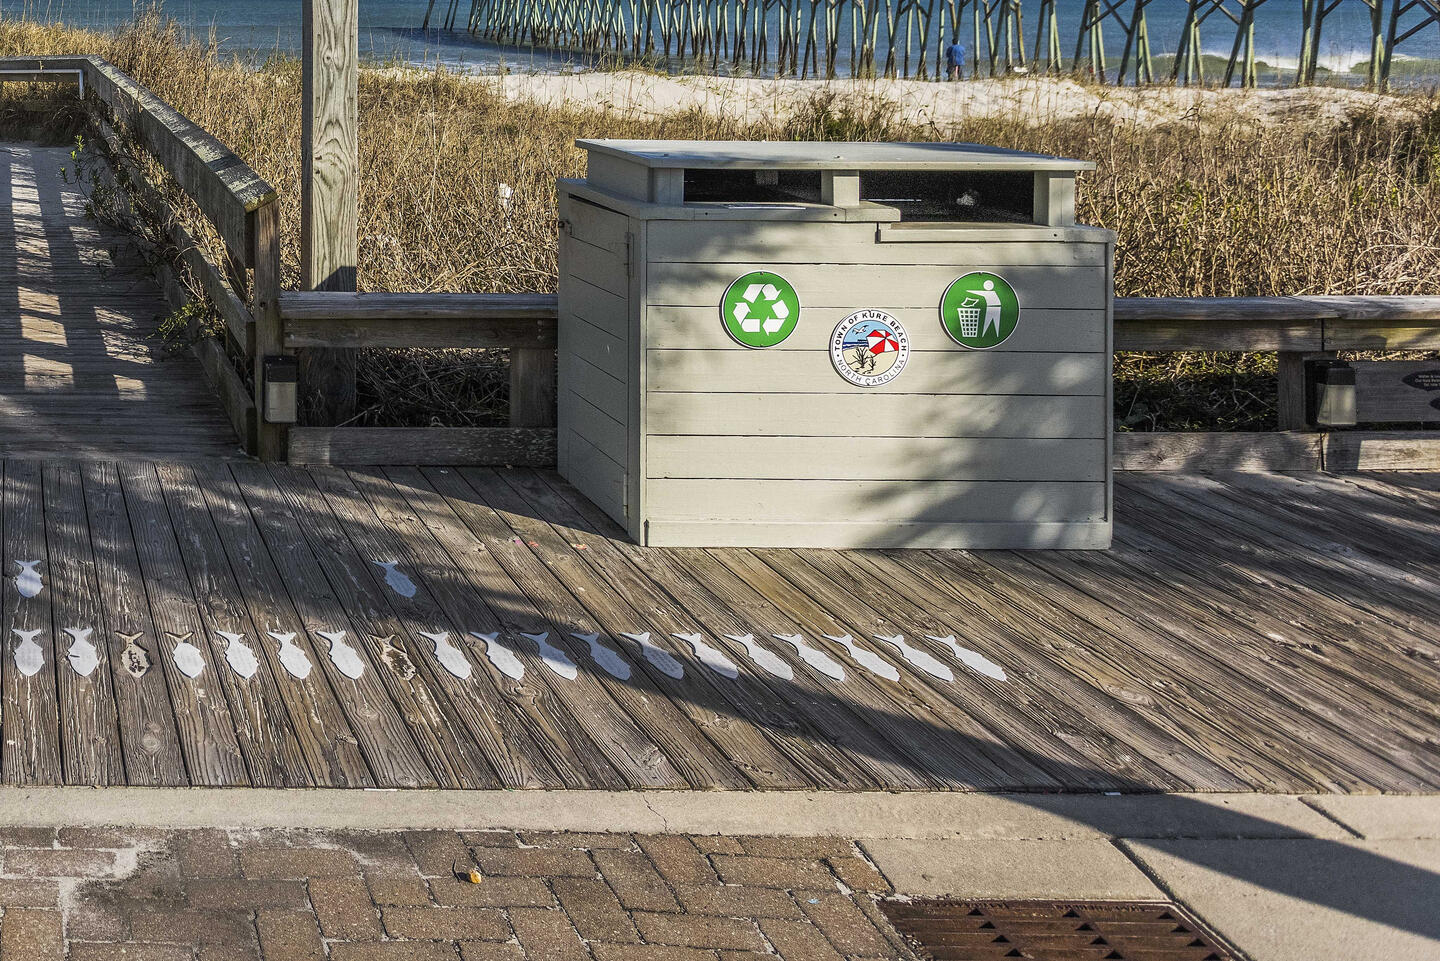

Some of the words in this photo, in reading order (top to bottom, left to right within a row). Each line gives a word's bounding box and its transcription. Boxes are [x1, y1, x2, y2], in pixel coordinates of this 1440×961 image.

[835, 324, 848, 351] TOWN
[848, 315, 858, 325] OF
[861, 312, 888, 322] KURE
[889, 320, 907, 351] BEACH
[837, 359, 863, 382] NORTH
[865, 360, 905, 385] CAROLINA
